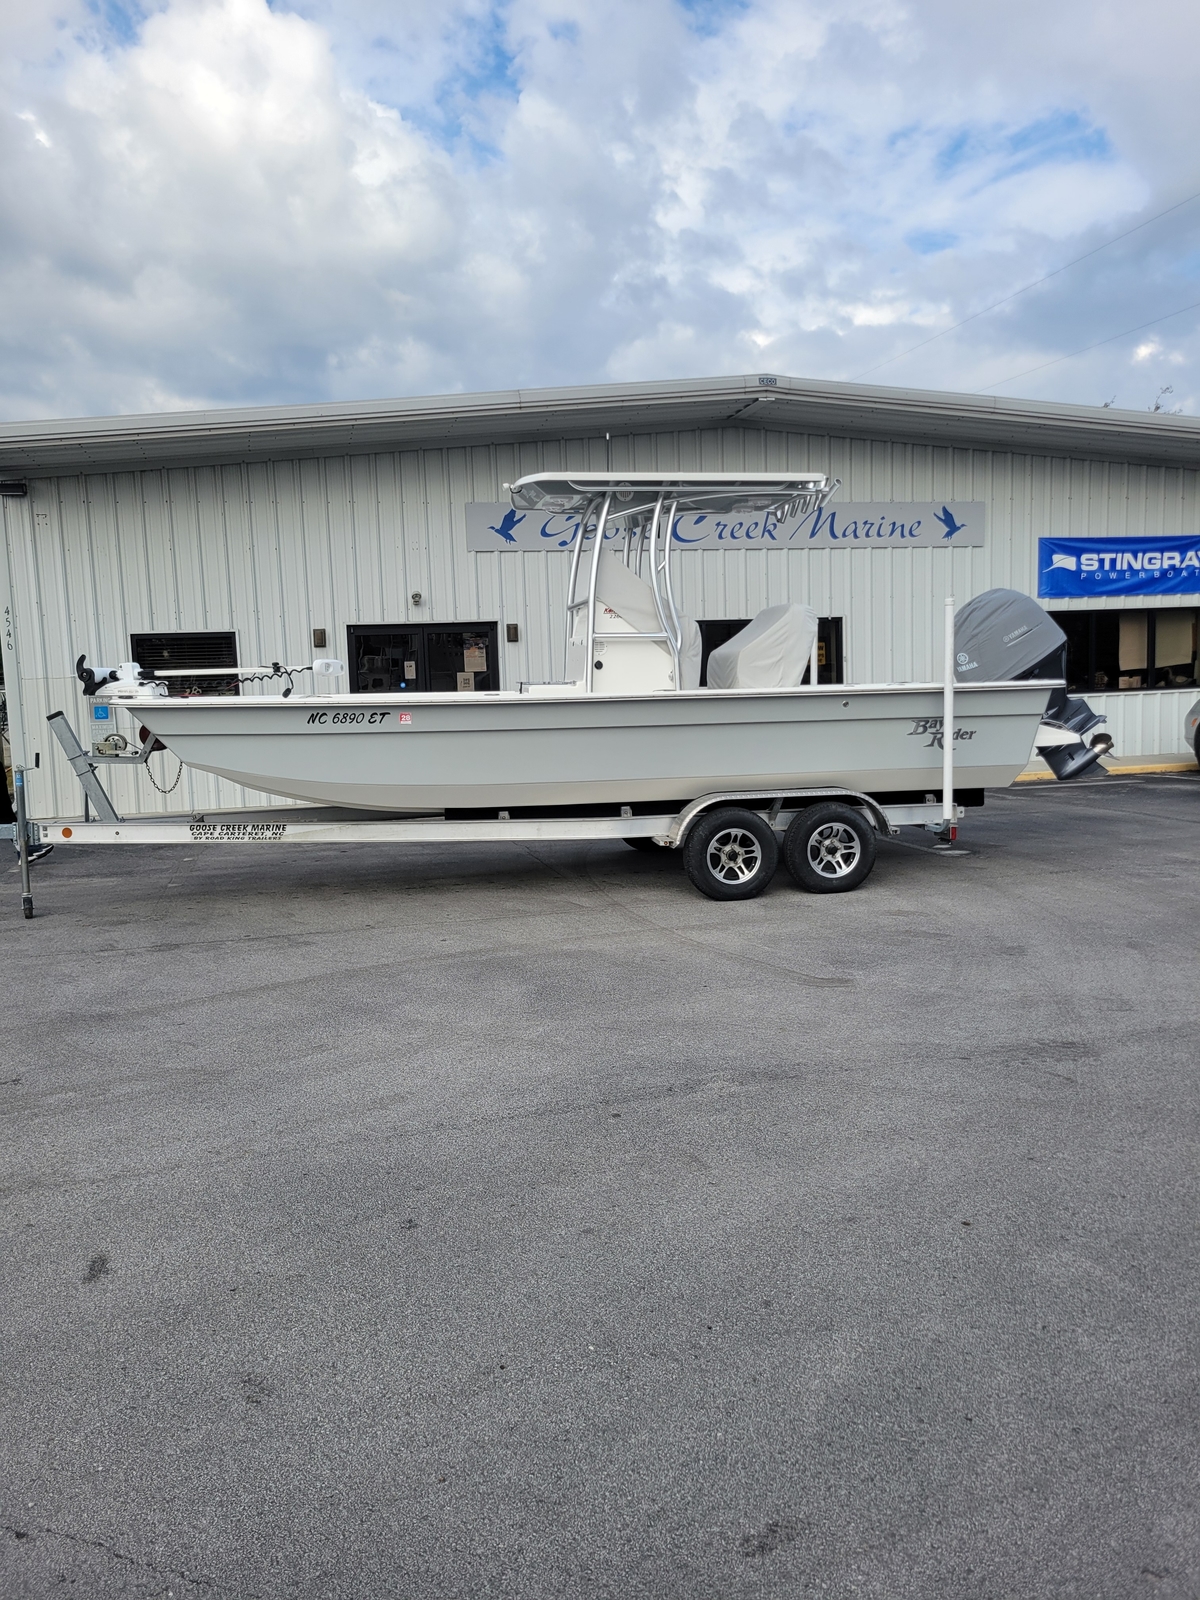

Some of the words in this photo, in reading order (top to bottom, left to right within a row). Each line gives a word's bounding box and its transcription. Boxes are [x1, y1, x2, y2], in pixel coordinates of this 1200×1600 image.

[671, 510, 778, 544] Creek
[788, 506, 922, 541] Marine
[1008, 625, 1028, 640] YAMAHA
[956, 661, 979, 673] YAMAHA
[307, 712, 329, 724] NC
[332, 712, 365, 724] 6890
[368, 712, 392, 724] ET
[923, 728, 977, 751] Rder
[189, 824, 218, 832] GOOSE
[220, 824, 249, 832] CREEK
[251, 824, 287, 832] MARINE
